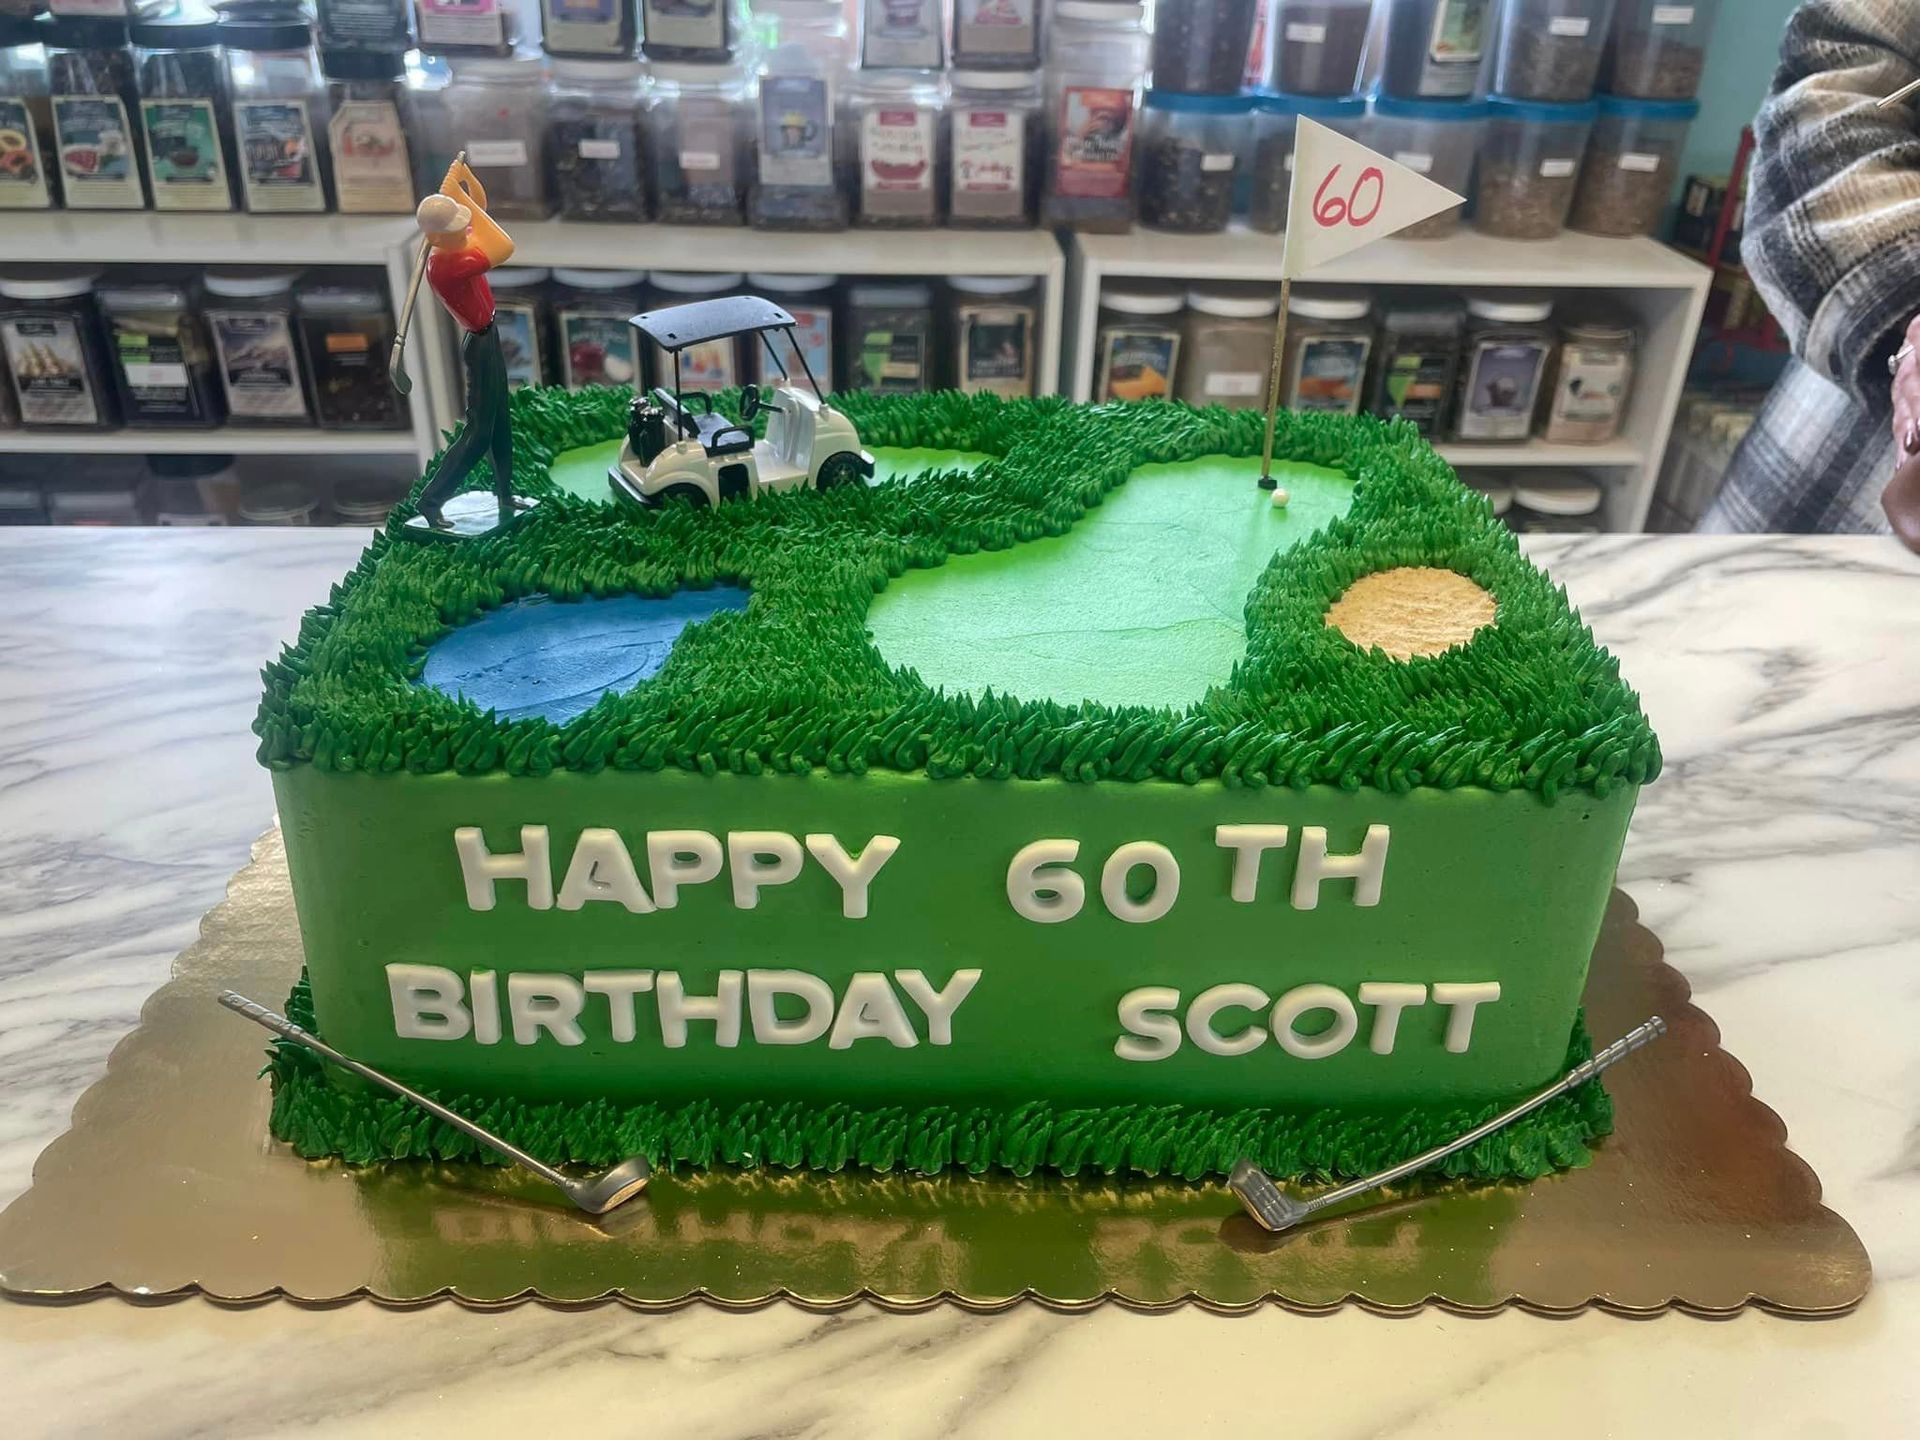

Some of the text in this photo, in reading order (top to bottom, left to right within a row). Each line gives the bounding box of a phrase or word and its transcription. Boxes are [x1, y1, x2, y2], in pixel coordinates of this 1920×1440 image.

[1312, 163, 1384, 228] 60
[454, 824, 901, 919] HAPPY
[385, 962, 1501, 1062] BIRTHDAY SCOTT
